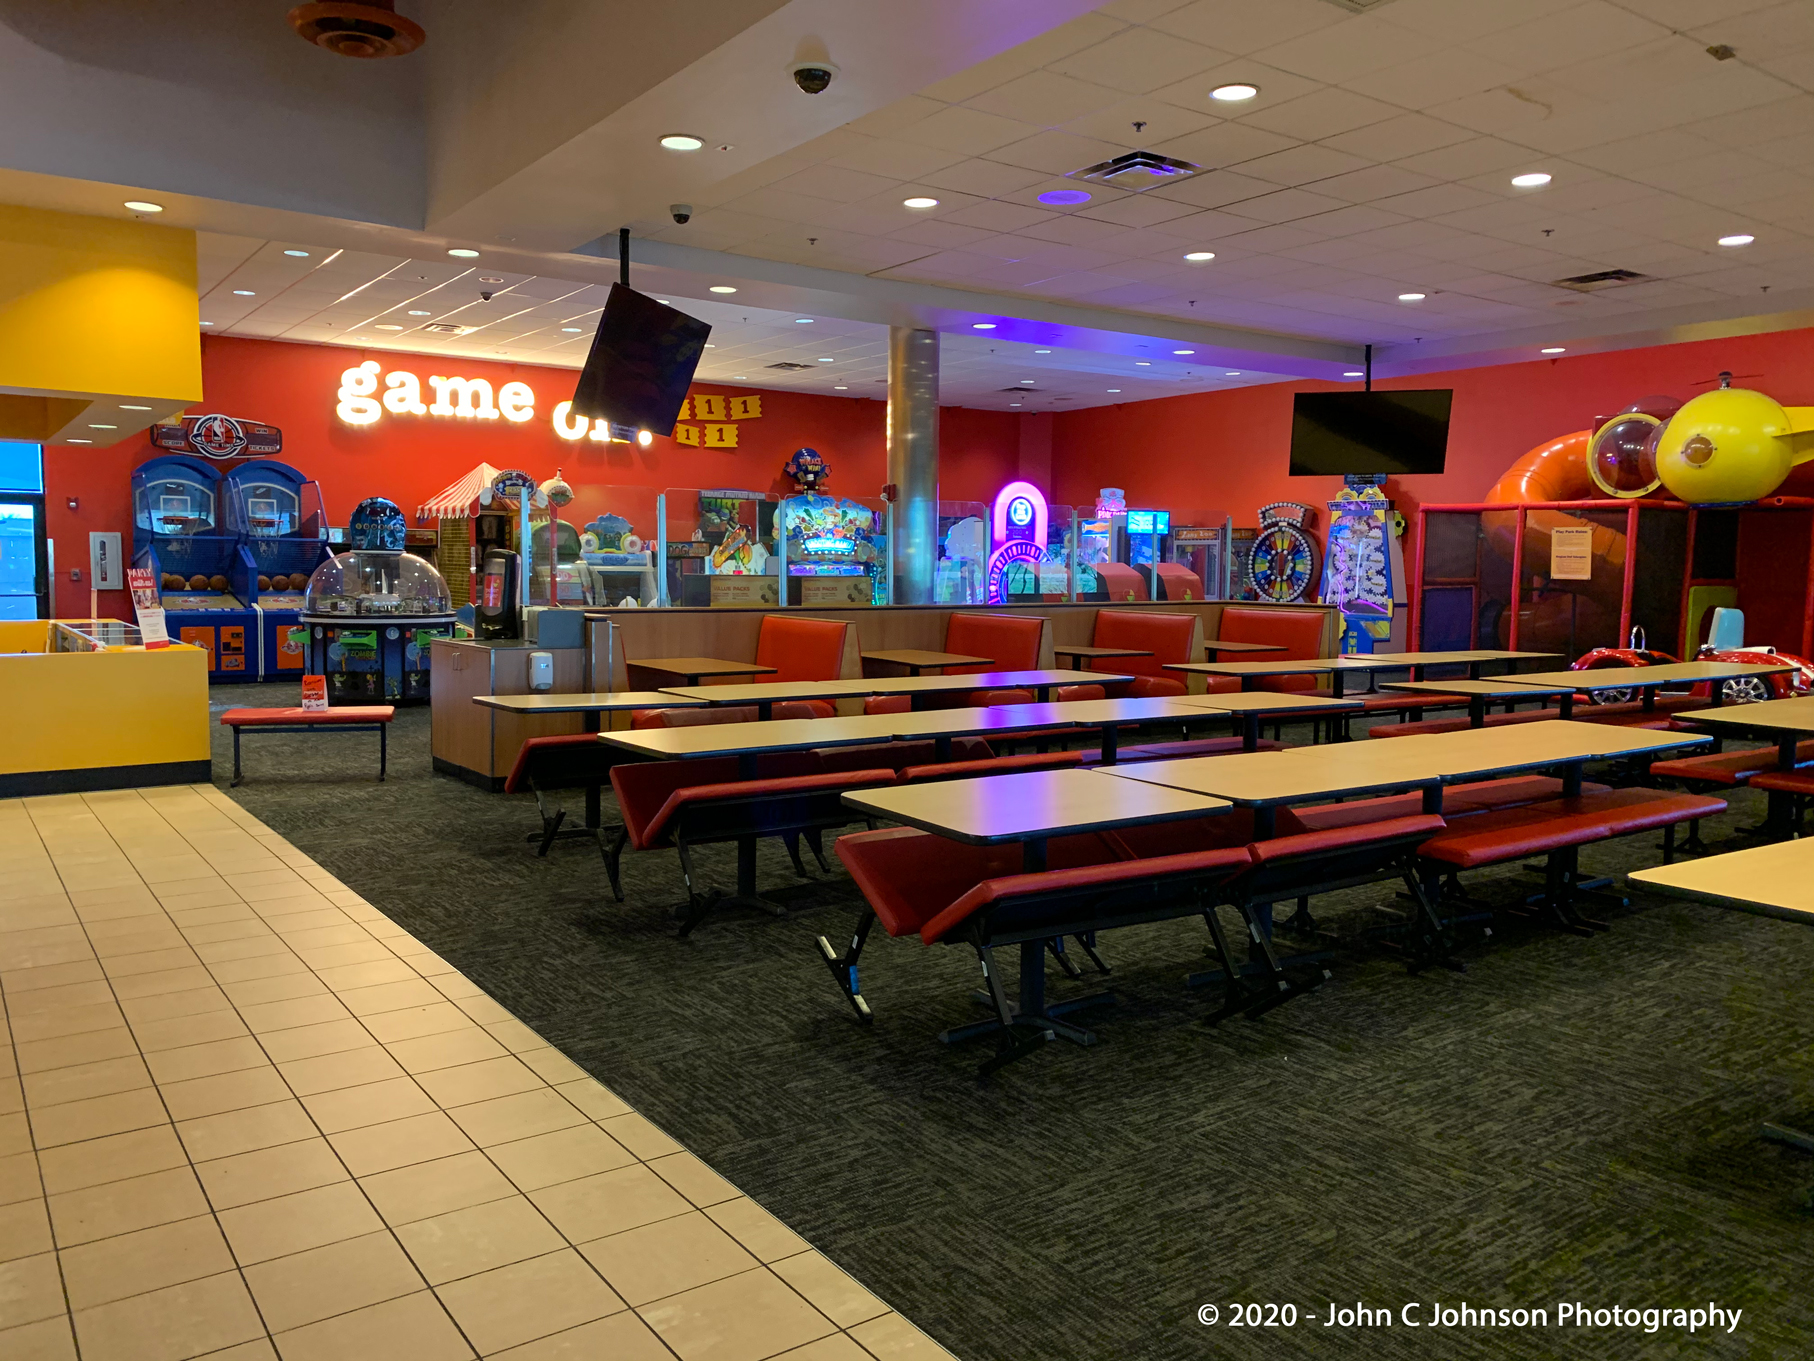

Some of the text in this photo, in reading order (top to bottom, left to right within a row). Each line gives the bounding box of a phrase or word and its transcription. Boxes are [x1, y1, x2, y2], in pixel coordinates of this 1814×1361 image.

[336, 360, 535, 425] game
[705, 398, 715, 415] 1
[740, 399, 750, 414] 1
[684, 428, 691, 441] 1
[716, 427, 726, 442] 1
[350, 650, 377, 658] ZOMBIE
